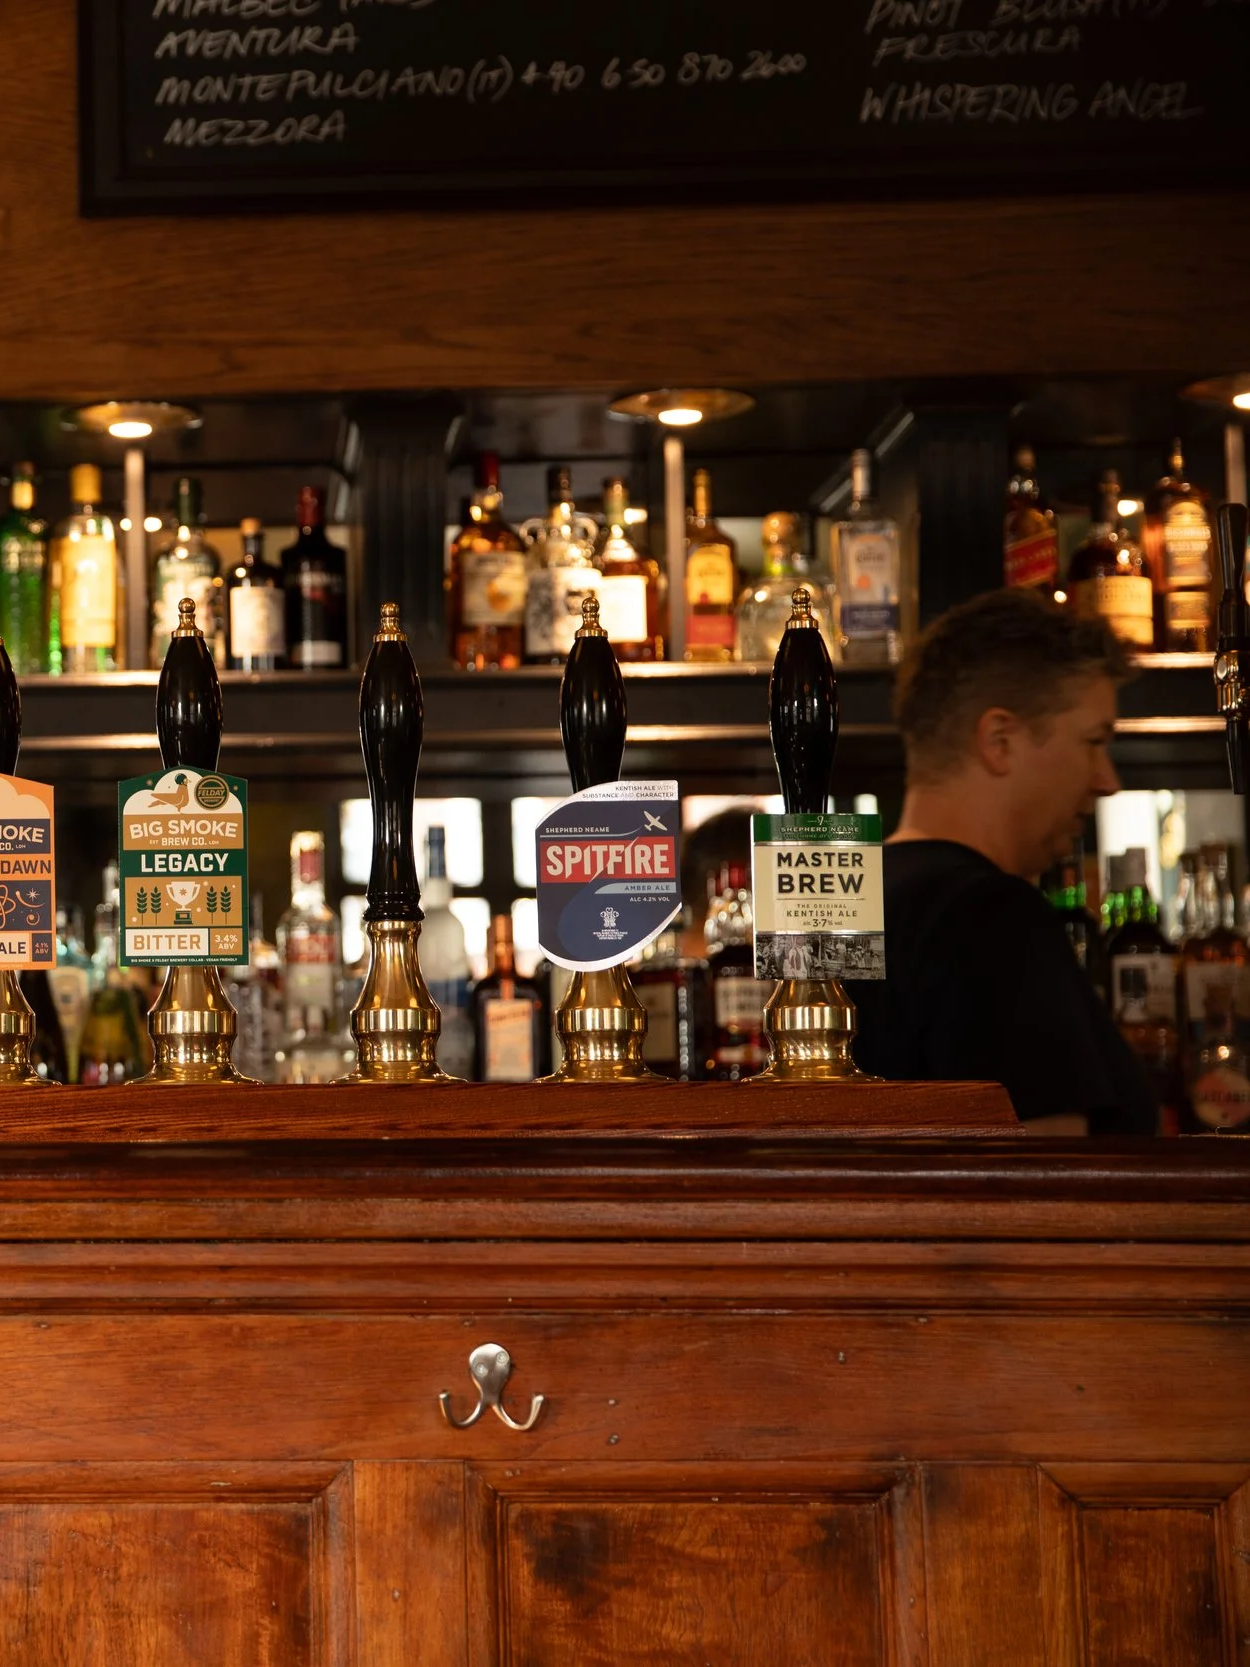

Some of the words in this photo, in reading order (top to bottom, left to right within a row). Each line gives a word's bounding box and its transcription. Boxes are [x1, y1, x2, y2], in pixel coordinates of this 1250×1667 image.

[153, 22, 361, 61] AVENTURA
[870, 25, 1083, 68] FRESCURA
[859, 80, 1080, 125] WHISPERING
[1087, 76, 1206, 121] ANGEL
[163, 109, 348, 148] MEZZORA
[129, 821, 163, 840] BIG
[168, 819, 238, 838] SMOKE
[0, 842, 14, 851] CO.
[161, 837, 189, 846] BREW
[191, 837, 207, 846] CO.
[0, 859, 52, 875] DAWN
[141, 853, 229, 873] LEGACY
[546, 840, 670, 881] SPITFIRE
[777, 852, 863, 867] MASTER
[777, 873, 864, 894] BREW
[133, 934, 201, 950] BITTER
[215, 934, 238, 943] 3.4%
